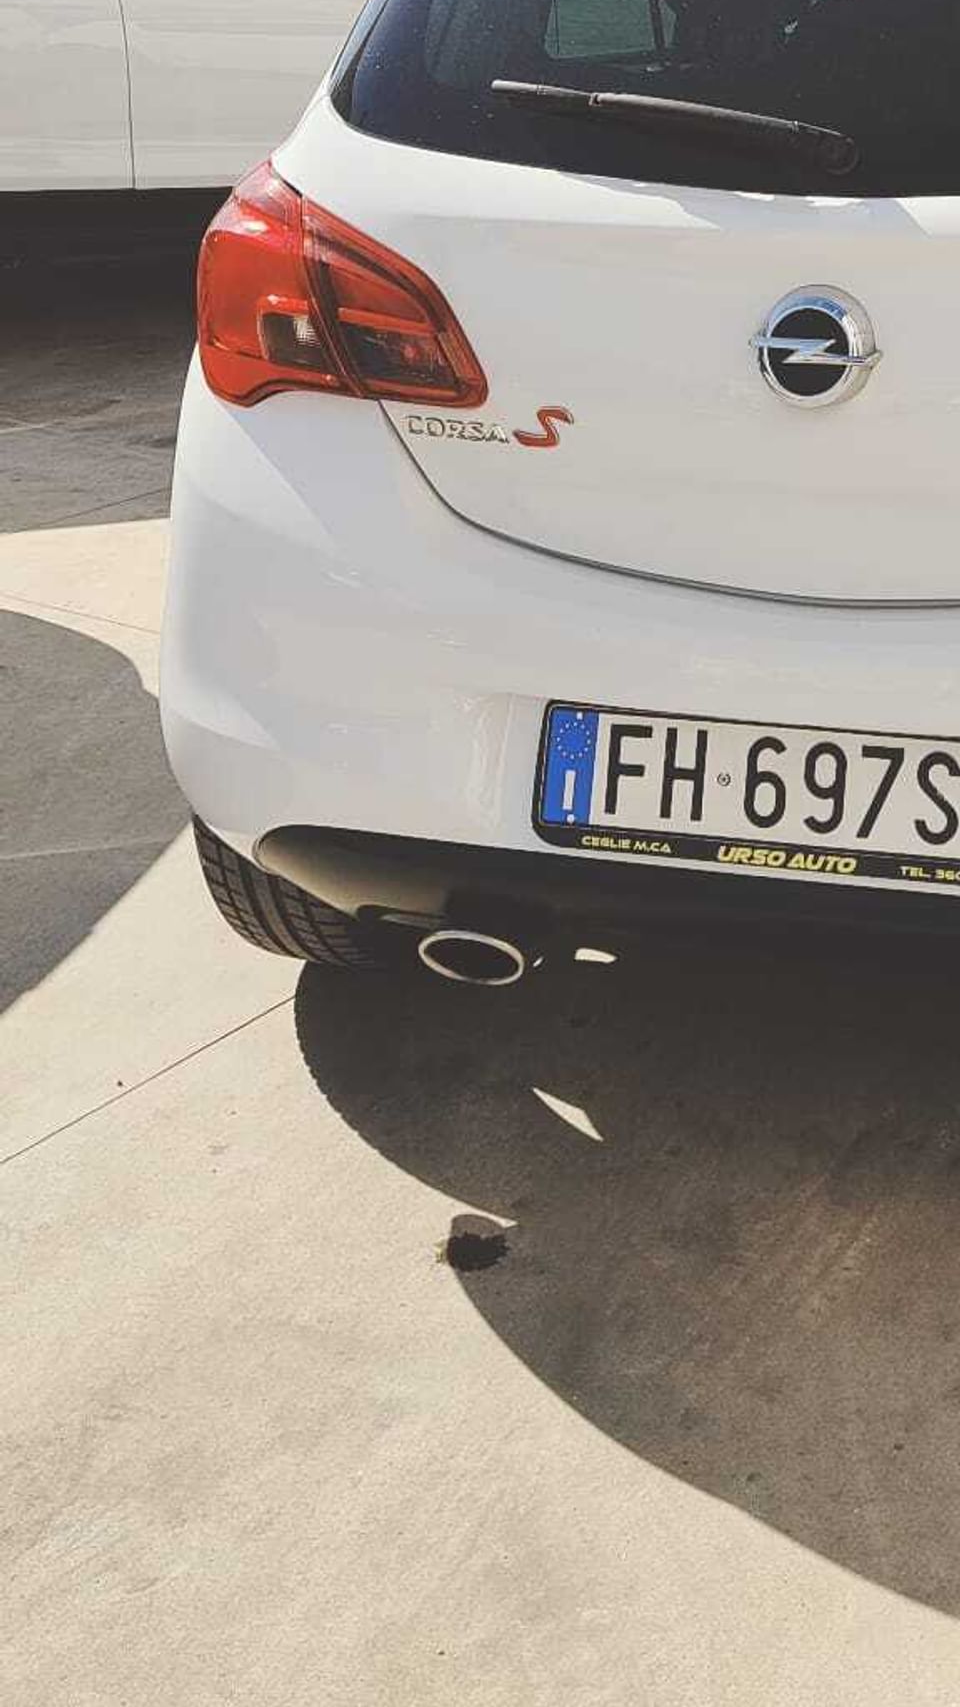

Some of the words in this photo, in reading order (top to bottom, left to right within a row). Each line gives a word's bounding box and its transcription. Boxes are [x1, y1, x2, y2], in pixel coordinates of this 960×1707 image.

[406, 414, 509, 443] CORSA
[512, 406, 574, 447] S
[604, 723, 709, 822] FH
[581, 835, 631, 849] CEGLIE
[717, 845, 786, 867] URSO
[788, 852, 858, 874] AUTO
